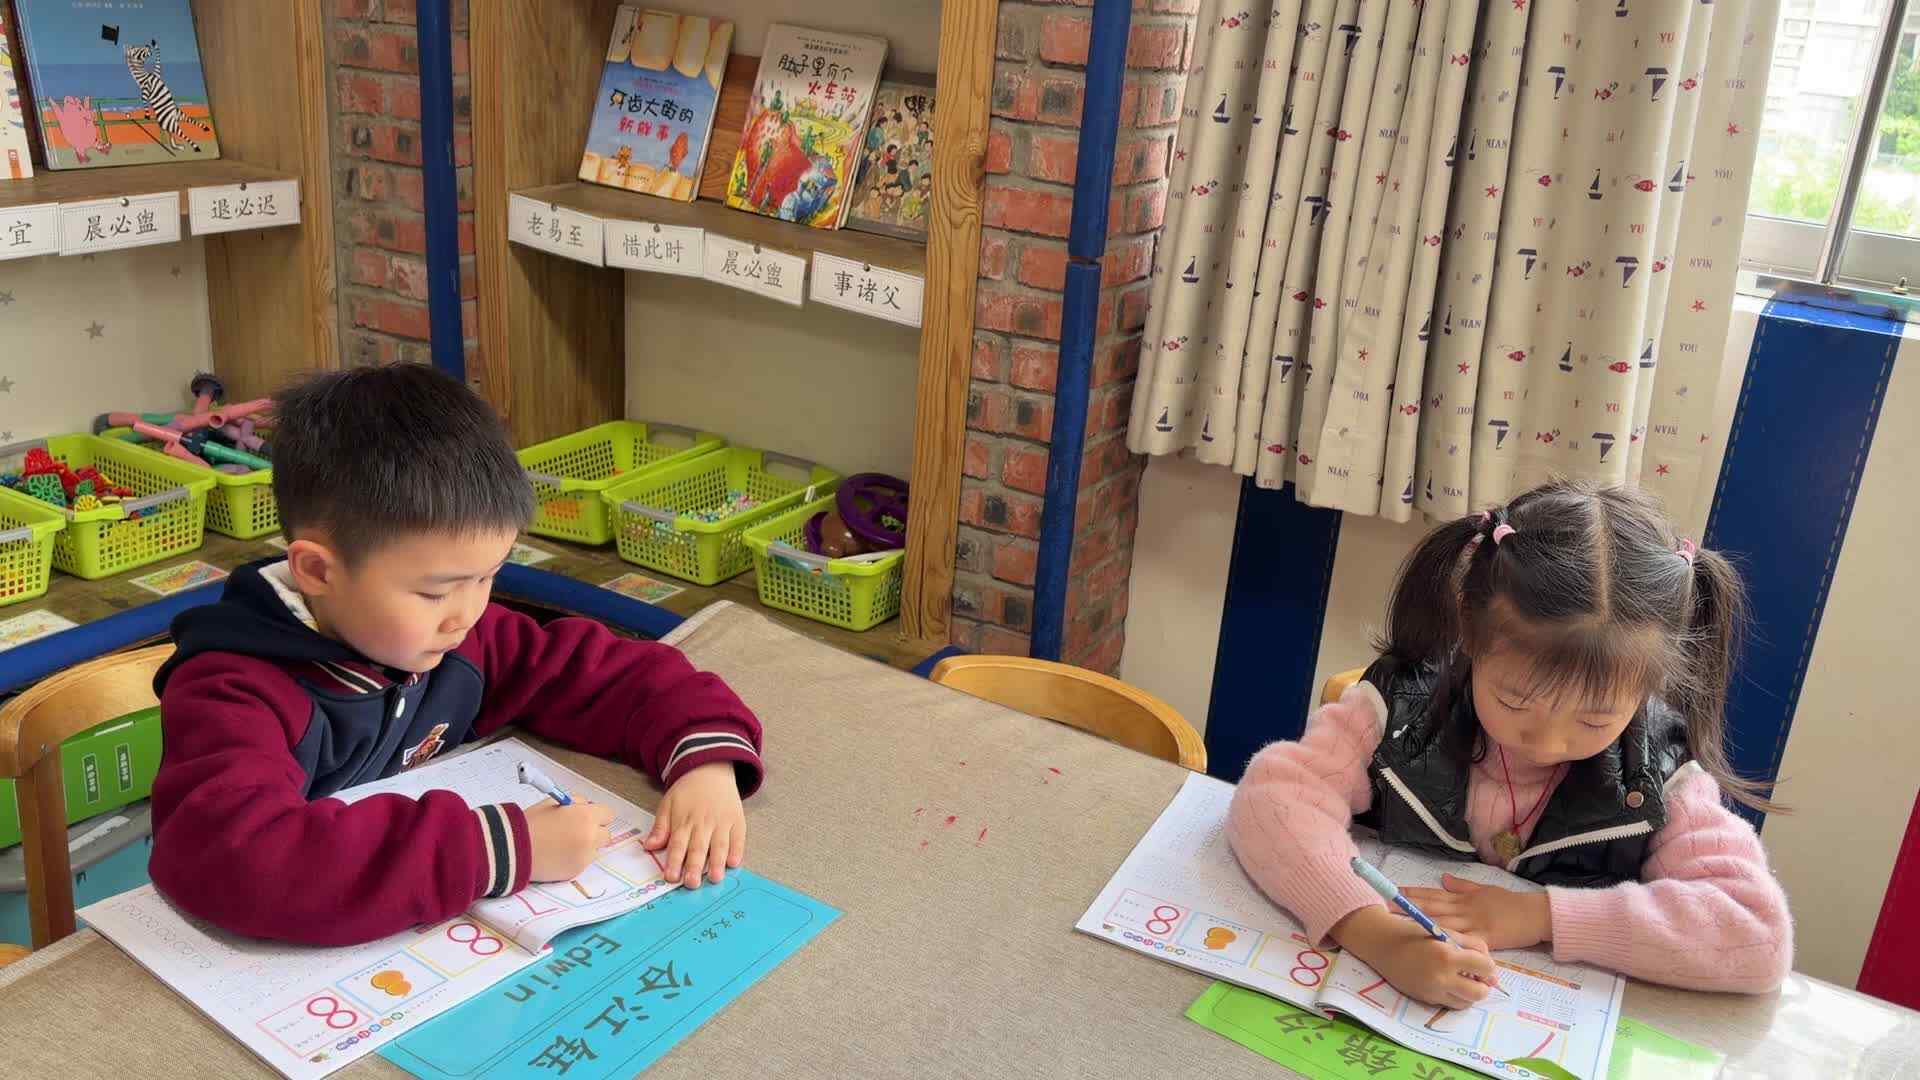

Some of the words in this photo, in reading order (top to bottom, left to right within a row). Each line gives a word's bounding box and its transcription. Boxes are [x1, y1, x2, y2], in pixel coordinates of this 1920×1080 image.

[778, 54, 854, 81] 肚子里有个
[609, 88, 694, 123] 牙齿大街的
[808, 80, 857, 105] 火车站
[210, 193, 279, 221] 退必迟
[0, 220, 32, 246] 宜
[82, 208, 158, 243] 晨必盥
[527, 211, 585, 247] 老易至
[622, 233, 685, 264] 惜此时
[720, 250, 783, 288] 晨必盥
[833, 269, 901, 311] 事诸父
[502, 932, 622, 1004] Edwin
[527, 960, 694, 1076] 谷江钰
